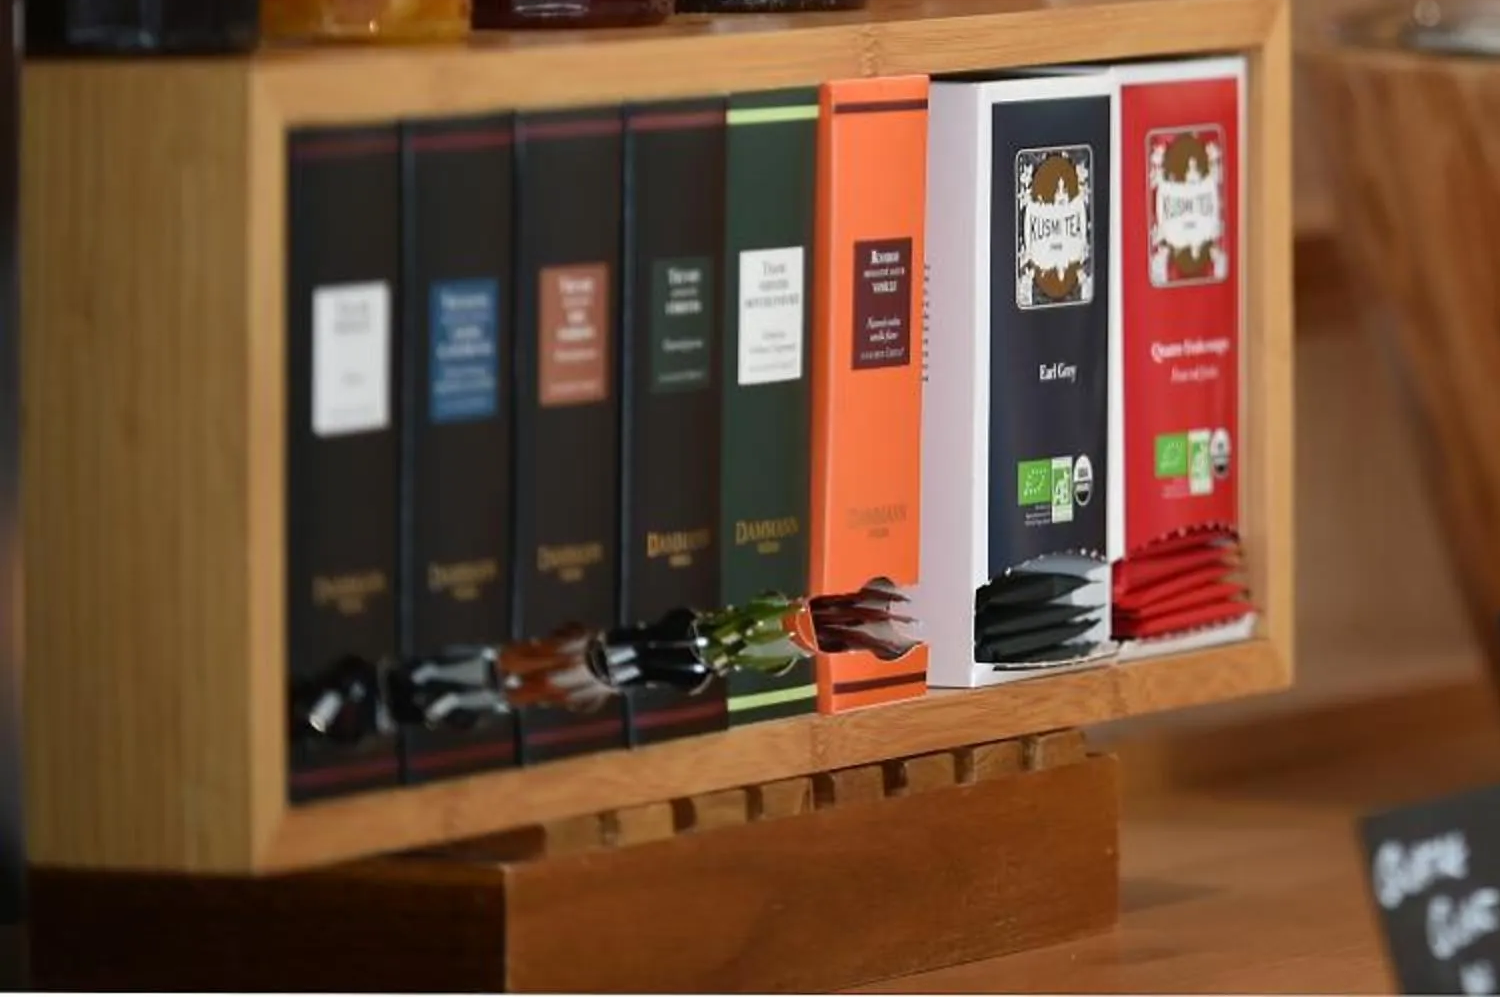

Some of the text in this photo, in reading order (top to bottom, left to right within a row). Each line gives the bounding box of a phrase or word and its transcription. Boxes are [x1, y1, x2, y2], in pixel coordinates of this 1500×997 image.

[1030, 212, 1082, 242] KUSMI TEA
[1039, 362, 1057, 380] Earl
